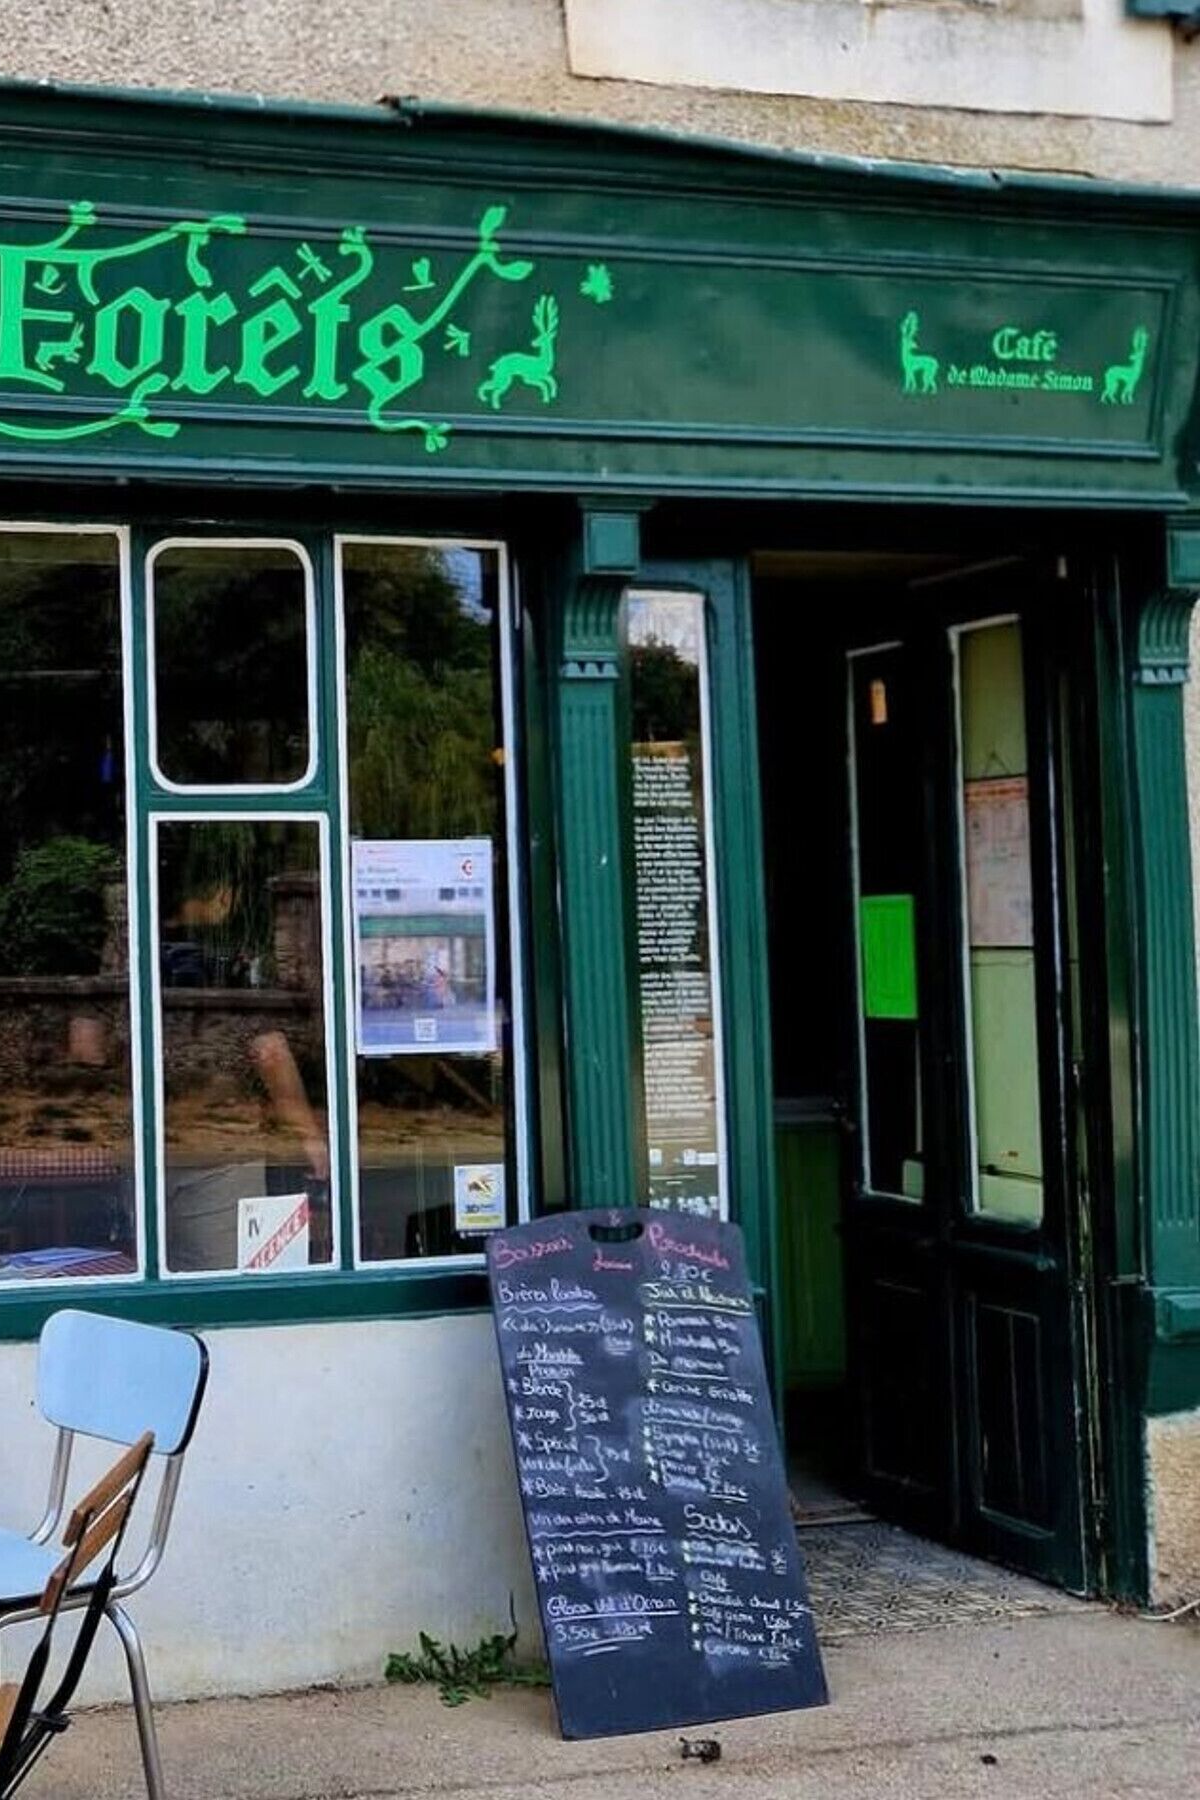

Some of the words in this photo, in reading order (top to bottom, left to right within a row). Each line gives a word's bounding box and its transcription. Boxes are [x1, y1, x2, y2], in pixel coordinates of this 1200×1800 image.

[993, 326, 1058, 361] Café
[946, 364, 967, 385] de
[969, 366, 1039, 389] Madame
[1041, 370, 1095, 392] Simon
